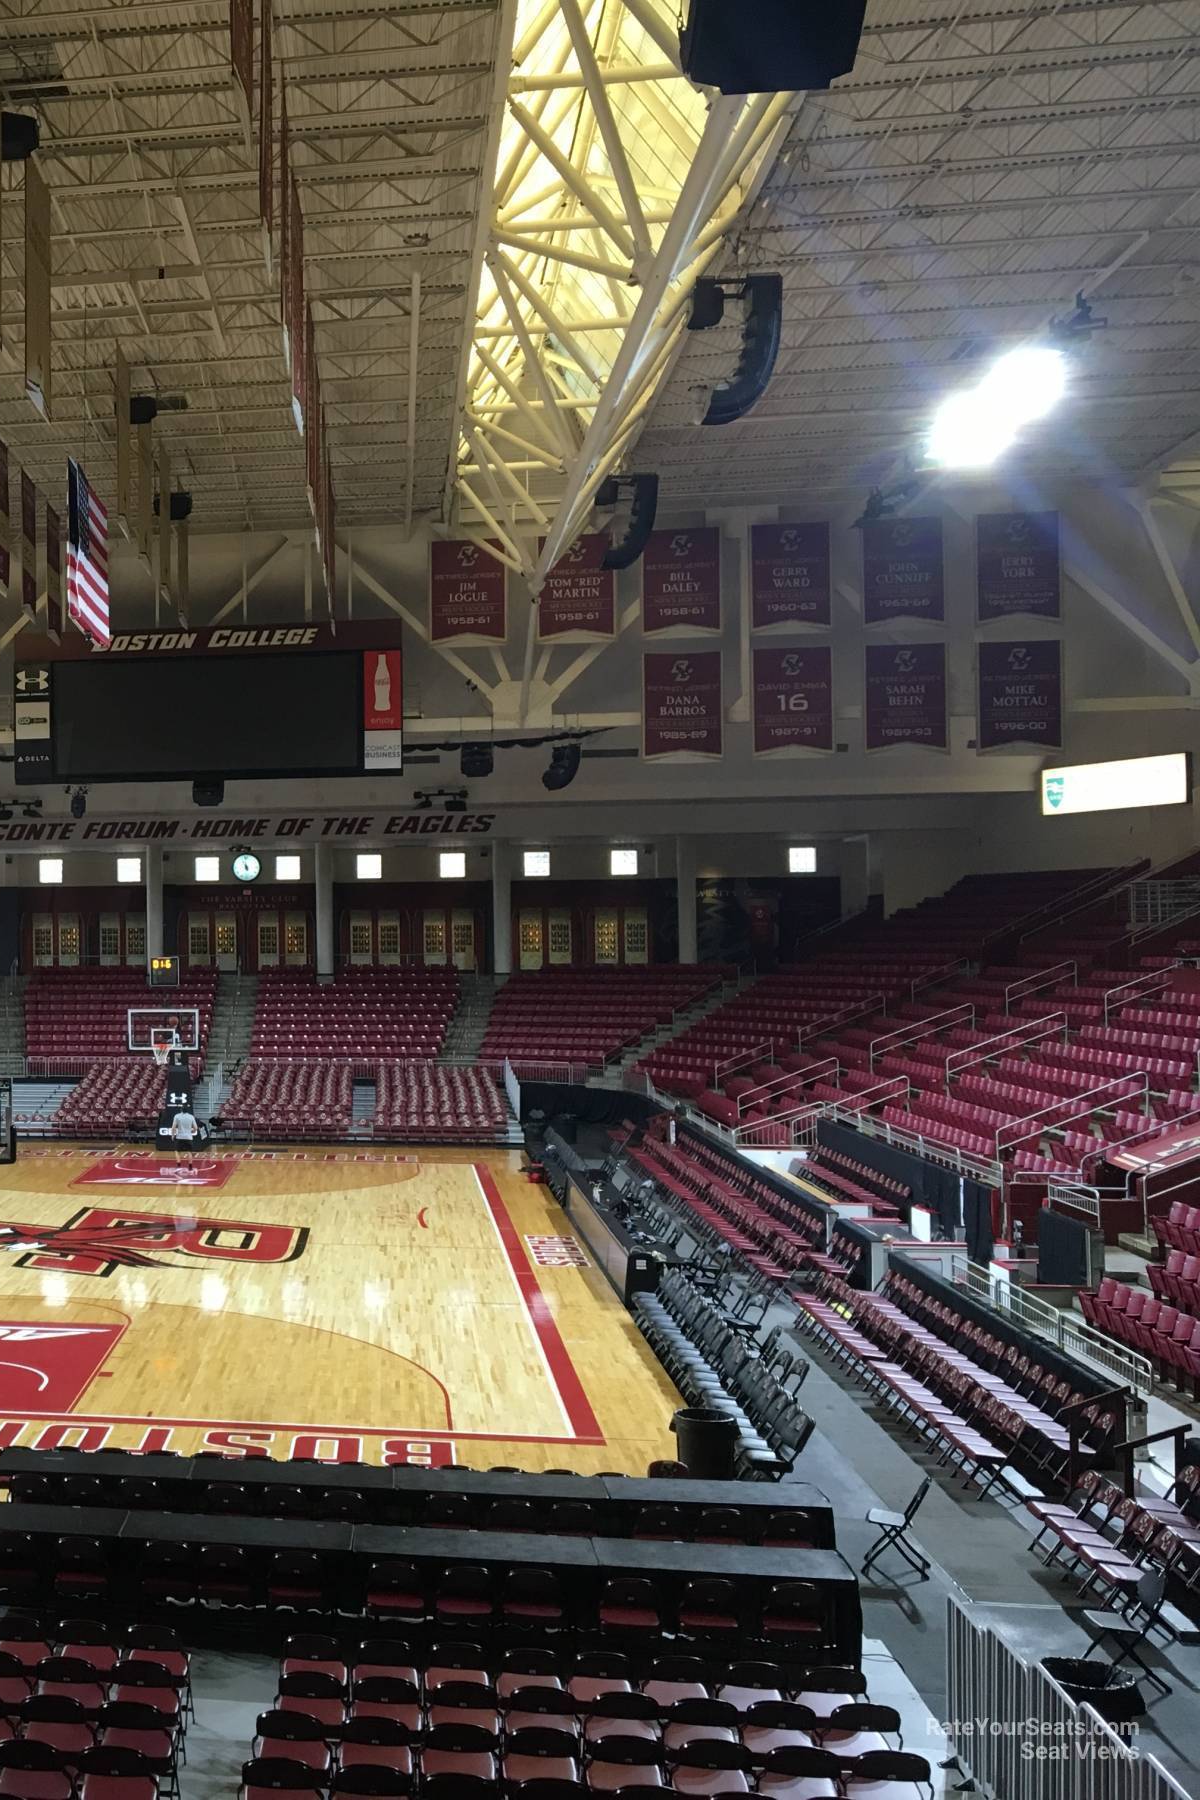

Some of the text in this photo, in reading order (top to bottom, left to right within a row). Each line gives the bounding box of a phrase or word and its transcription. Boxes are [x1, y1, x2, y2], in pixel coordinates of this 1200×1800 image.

[888, 562, 919, 572] JOHN
[1002, 557, 1035, 567] JERRY
[669, 572, 693, 582] BILL
[772, 567, 809, 577] GERRY
[1001, 567, 1037, 579] YORK
[548, 578, 572, 588] TOM
[772, 577, 811, 588] WARD
[875, 573, 932, 585] CUNNIFF
[460, 582, 476, 592] JIM
[662, 582, 702, 593] DALEY
[449, 592, 489, 602] LOGUE
[552, 588, 600, 599] MARTIN
[659, 606, 705, 617] 1958-61
[767, 602, 818, 612] 1960-63
[447, 615, 491, 625] 1958-61
[554, 612, 600, 621] 1958-61
[206, 628, 320, 649] COLLEGE
[758, 683, 791, 691] DAVID
[885, 684, 926, 695] SARAH
[1004, 685, 1037, 695] MIKE
[666, 695, 701, 705] DANA
[776, 693, 809, 711] 16
[888, 695, 924, 706] BEHN
[992, 696, 1048, 707] MOTTAU
[660, 705, 707, 716] BARROS
[370, 718, 395, 726] enjoy
[994, 721, 1047, 731] 1996-00
[770, 727, 818, 736] 1987-91
[881, 727, 932, 737] 1989-93
[25, 755, 50, 763] DELTA
[82, 821, 180, 840] FORUM
[190, 818, 271, 838] HOME
[275, 818, 314, 836] OF
[321, 816, 375, 835] THE
[383, 814, 497, 834] EAGLES
